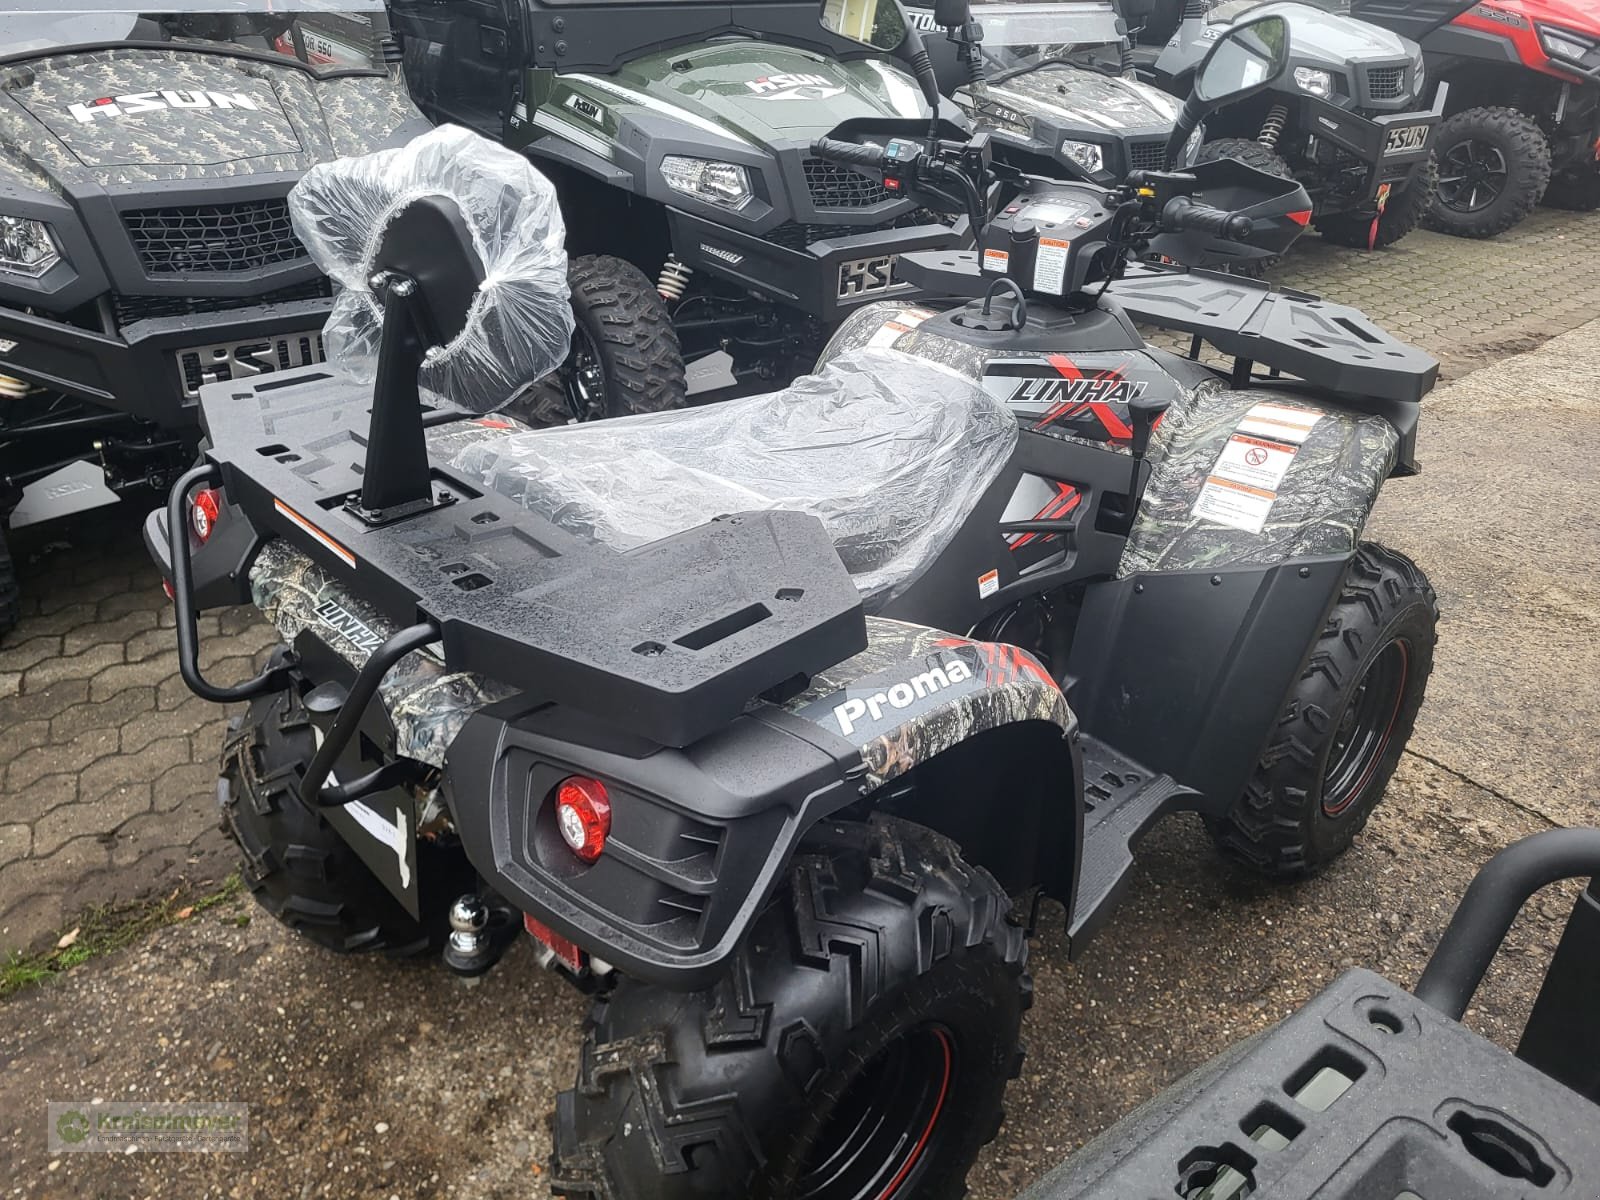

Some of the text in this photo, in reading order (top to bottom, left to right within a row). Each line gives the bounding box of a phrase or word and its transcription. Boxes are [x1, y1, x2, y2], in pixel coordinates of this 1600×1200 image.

[1202, 29, 1221, 41] 55
[317, 41, 332, 57] 550
[744, 74, 833, 94] HSUN
[67, 91, 258, 123] HSUN
[573, 97, 599, 119] HSUN
[995, 107, 1017, 121] 250
[832, 658, 972, 737] Proma
